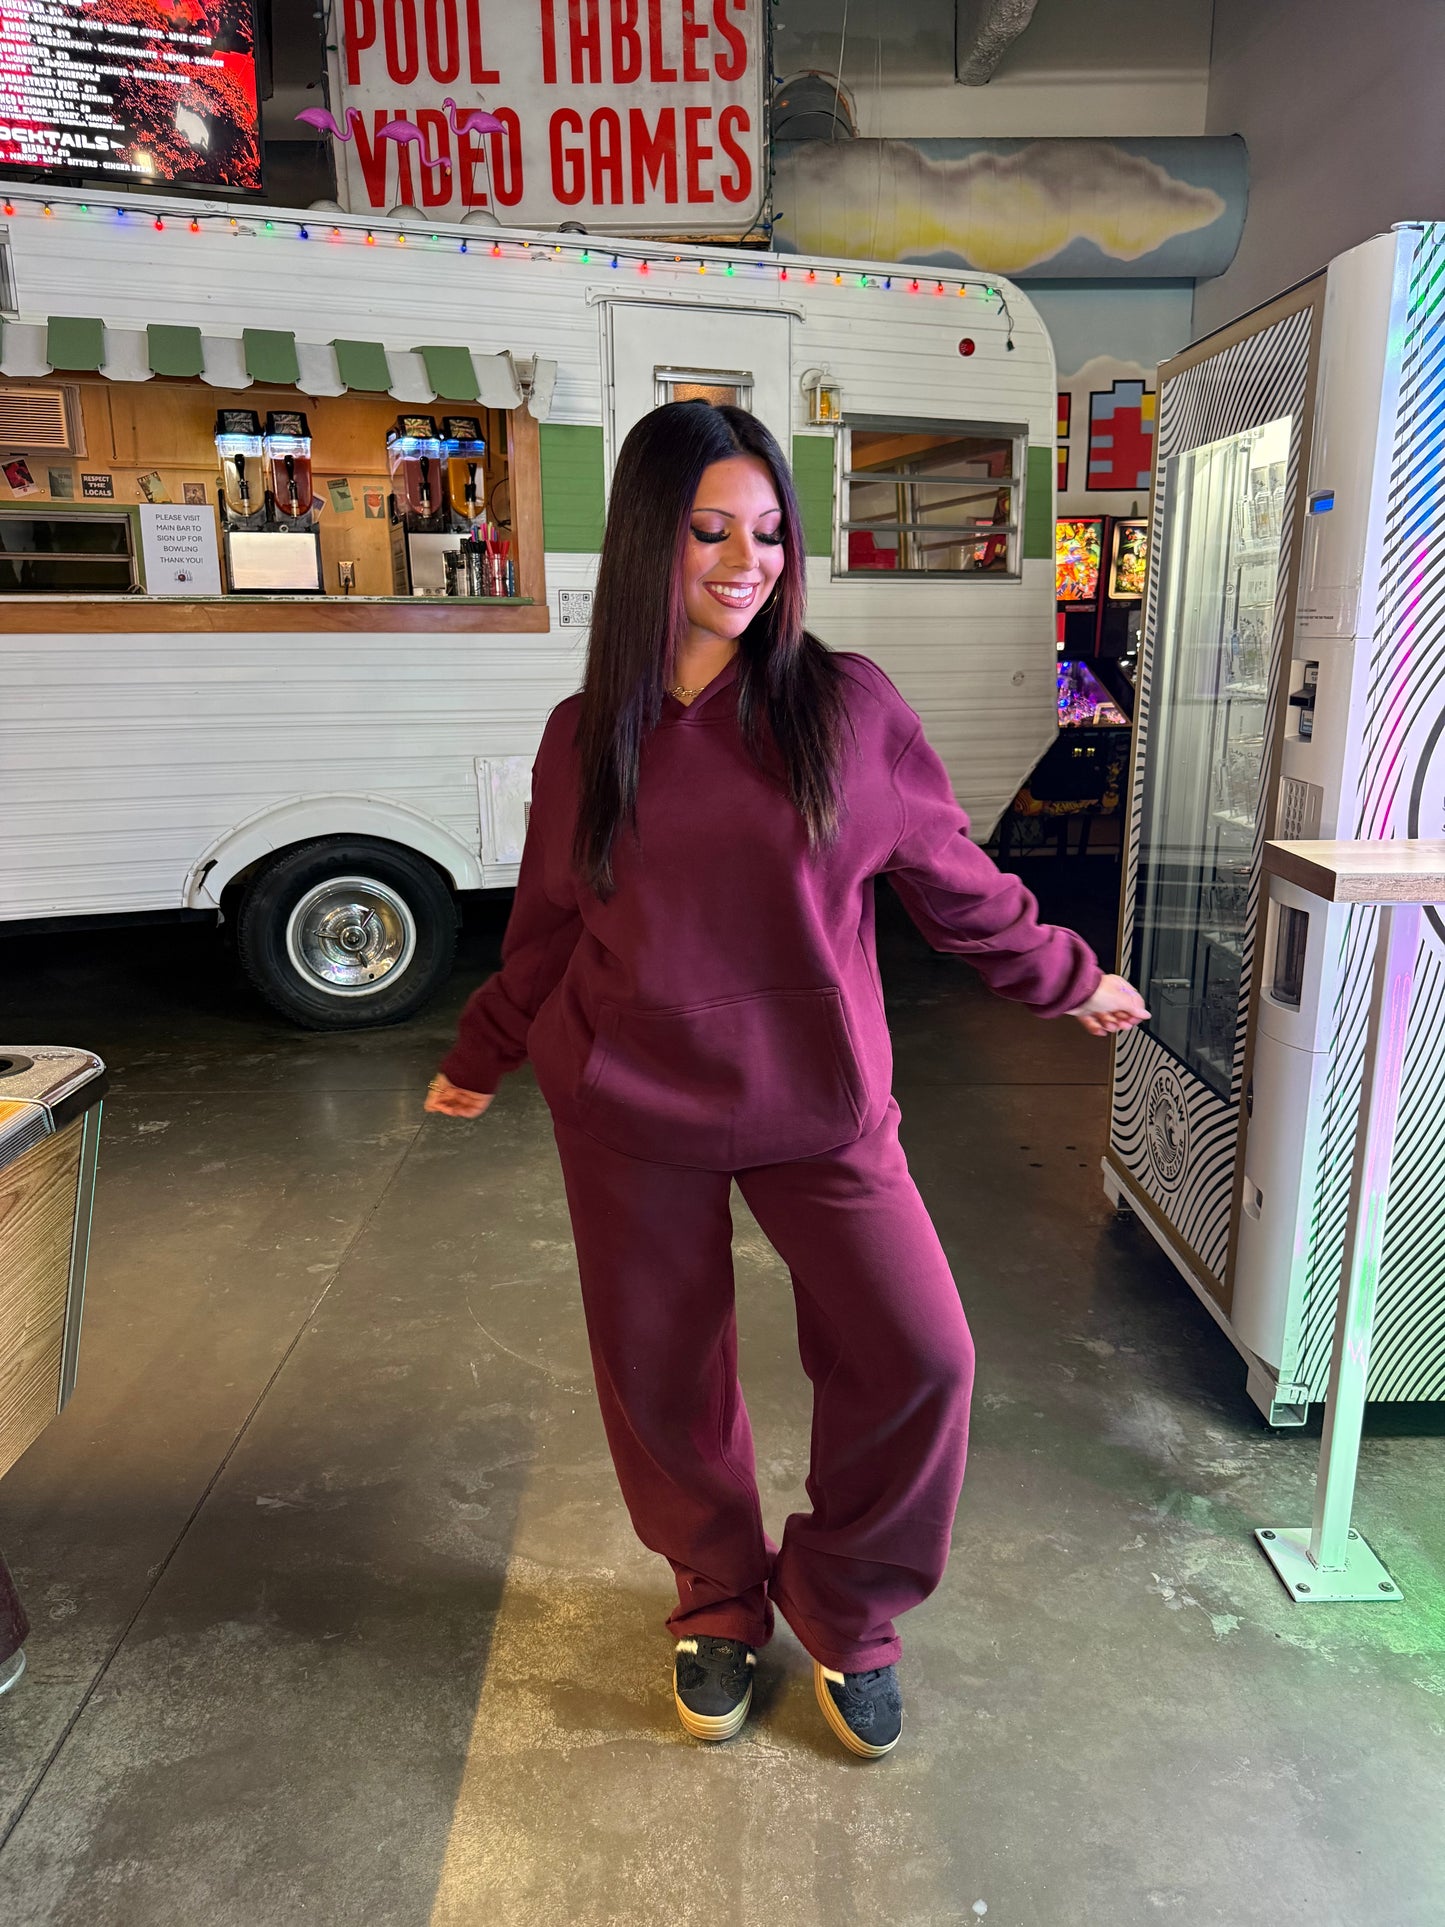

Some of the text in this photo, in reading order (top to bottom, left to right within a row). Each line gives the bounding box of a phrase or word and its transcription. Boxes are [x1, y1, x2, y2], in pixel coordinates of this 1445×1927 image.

[2, 20, 52, 37] HURRICANE
[33, 14, 78, 27] PINEAPPLE
[79, 19, 103, 31] JUICE
[107, 24, 138, 35] ORANGE
[169, 32, 188, 42] LIME
[189, 34, 212, 45] JUICE
[16, 44, 50, 58] RUNNER
[37, 36, 92, 51] PASSIONFRUIT
[163, 52, 190, 63] LEMON
[194, 56, 224, 67] ORANGE
[345, 0, 747, 85] POOL TABLES
[5, 54, 39, 65] LIQUEUR
[44, 58, 94, 72] BLACKBERRY
[96, 64, 129, 76] LIQUEUR
[32, 65, 52, 76] LIME
[57, 68, 100, 82] PINEAPPLE
[24, 76, 57, 89] STREET
[8, 84, 54, 97] PAINKILLER
[62, 91, 80, 100] RUM
[81, 93, 114, 104] RUNNER
[17, 95, 65, 110] LEMONADE
[53, 110, 80, 120] HONEY
[85, 113, 112, 123] MANGO
[10, 152, 38, 162] MANGO
[43, 156, 62, 164] LIME
[67, 158, 98, 168] BITTERS
[103, 162, 130, 171] GINGER
[357, 104, 752, 207] VIDEO GAMES
[1148, 1077, 1185, 1126] WHITE CLAW
[1152, 1138, 1184, 1176] HARD SELTZER
